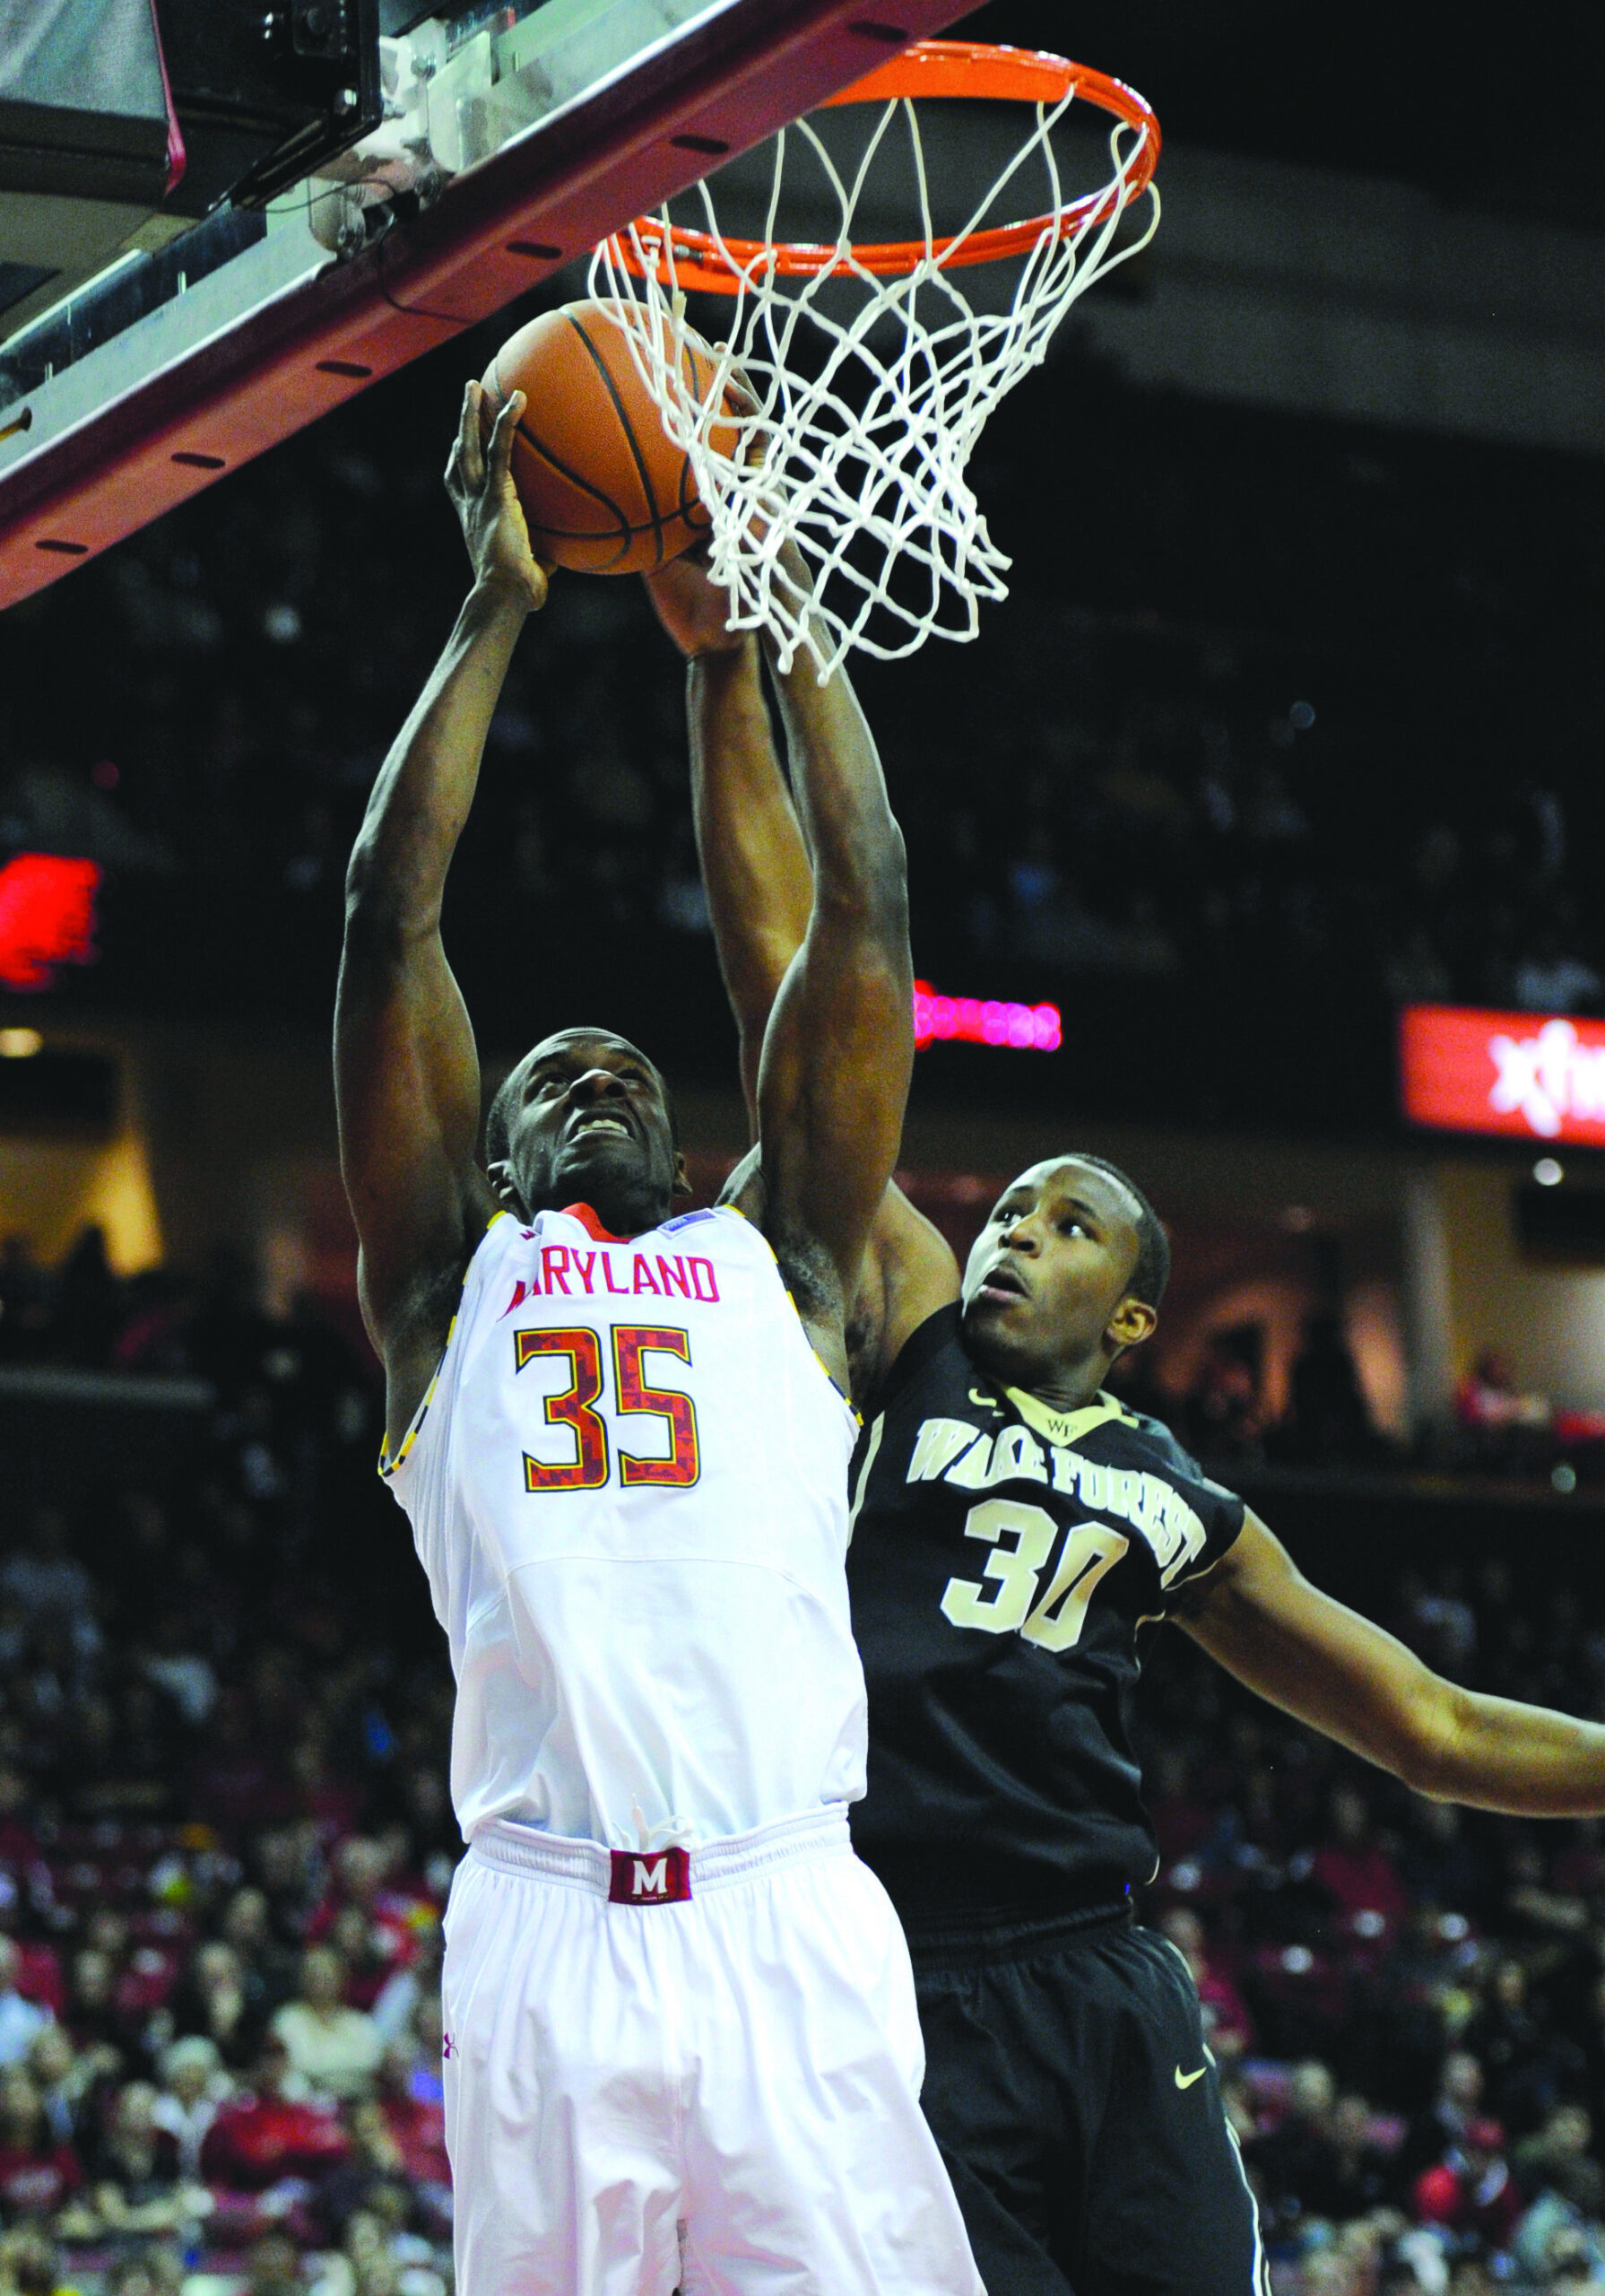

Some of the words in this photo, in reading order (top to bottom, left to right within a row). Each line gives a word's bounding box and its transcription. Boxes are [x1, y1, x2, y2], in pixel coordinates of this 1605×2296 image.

[497, 1245, 720, 1322] RYLAND
[514, 1324, 701, 1492] 35
[940, 1498, 1130, 1652] 30
[1050, 1446, 1207, 1590] FOREST
[631, 1857, 668, 1895] M
